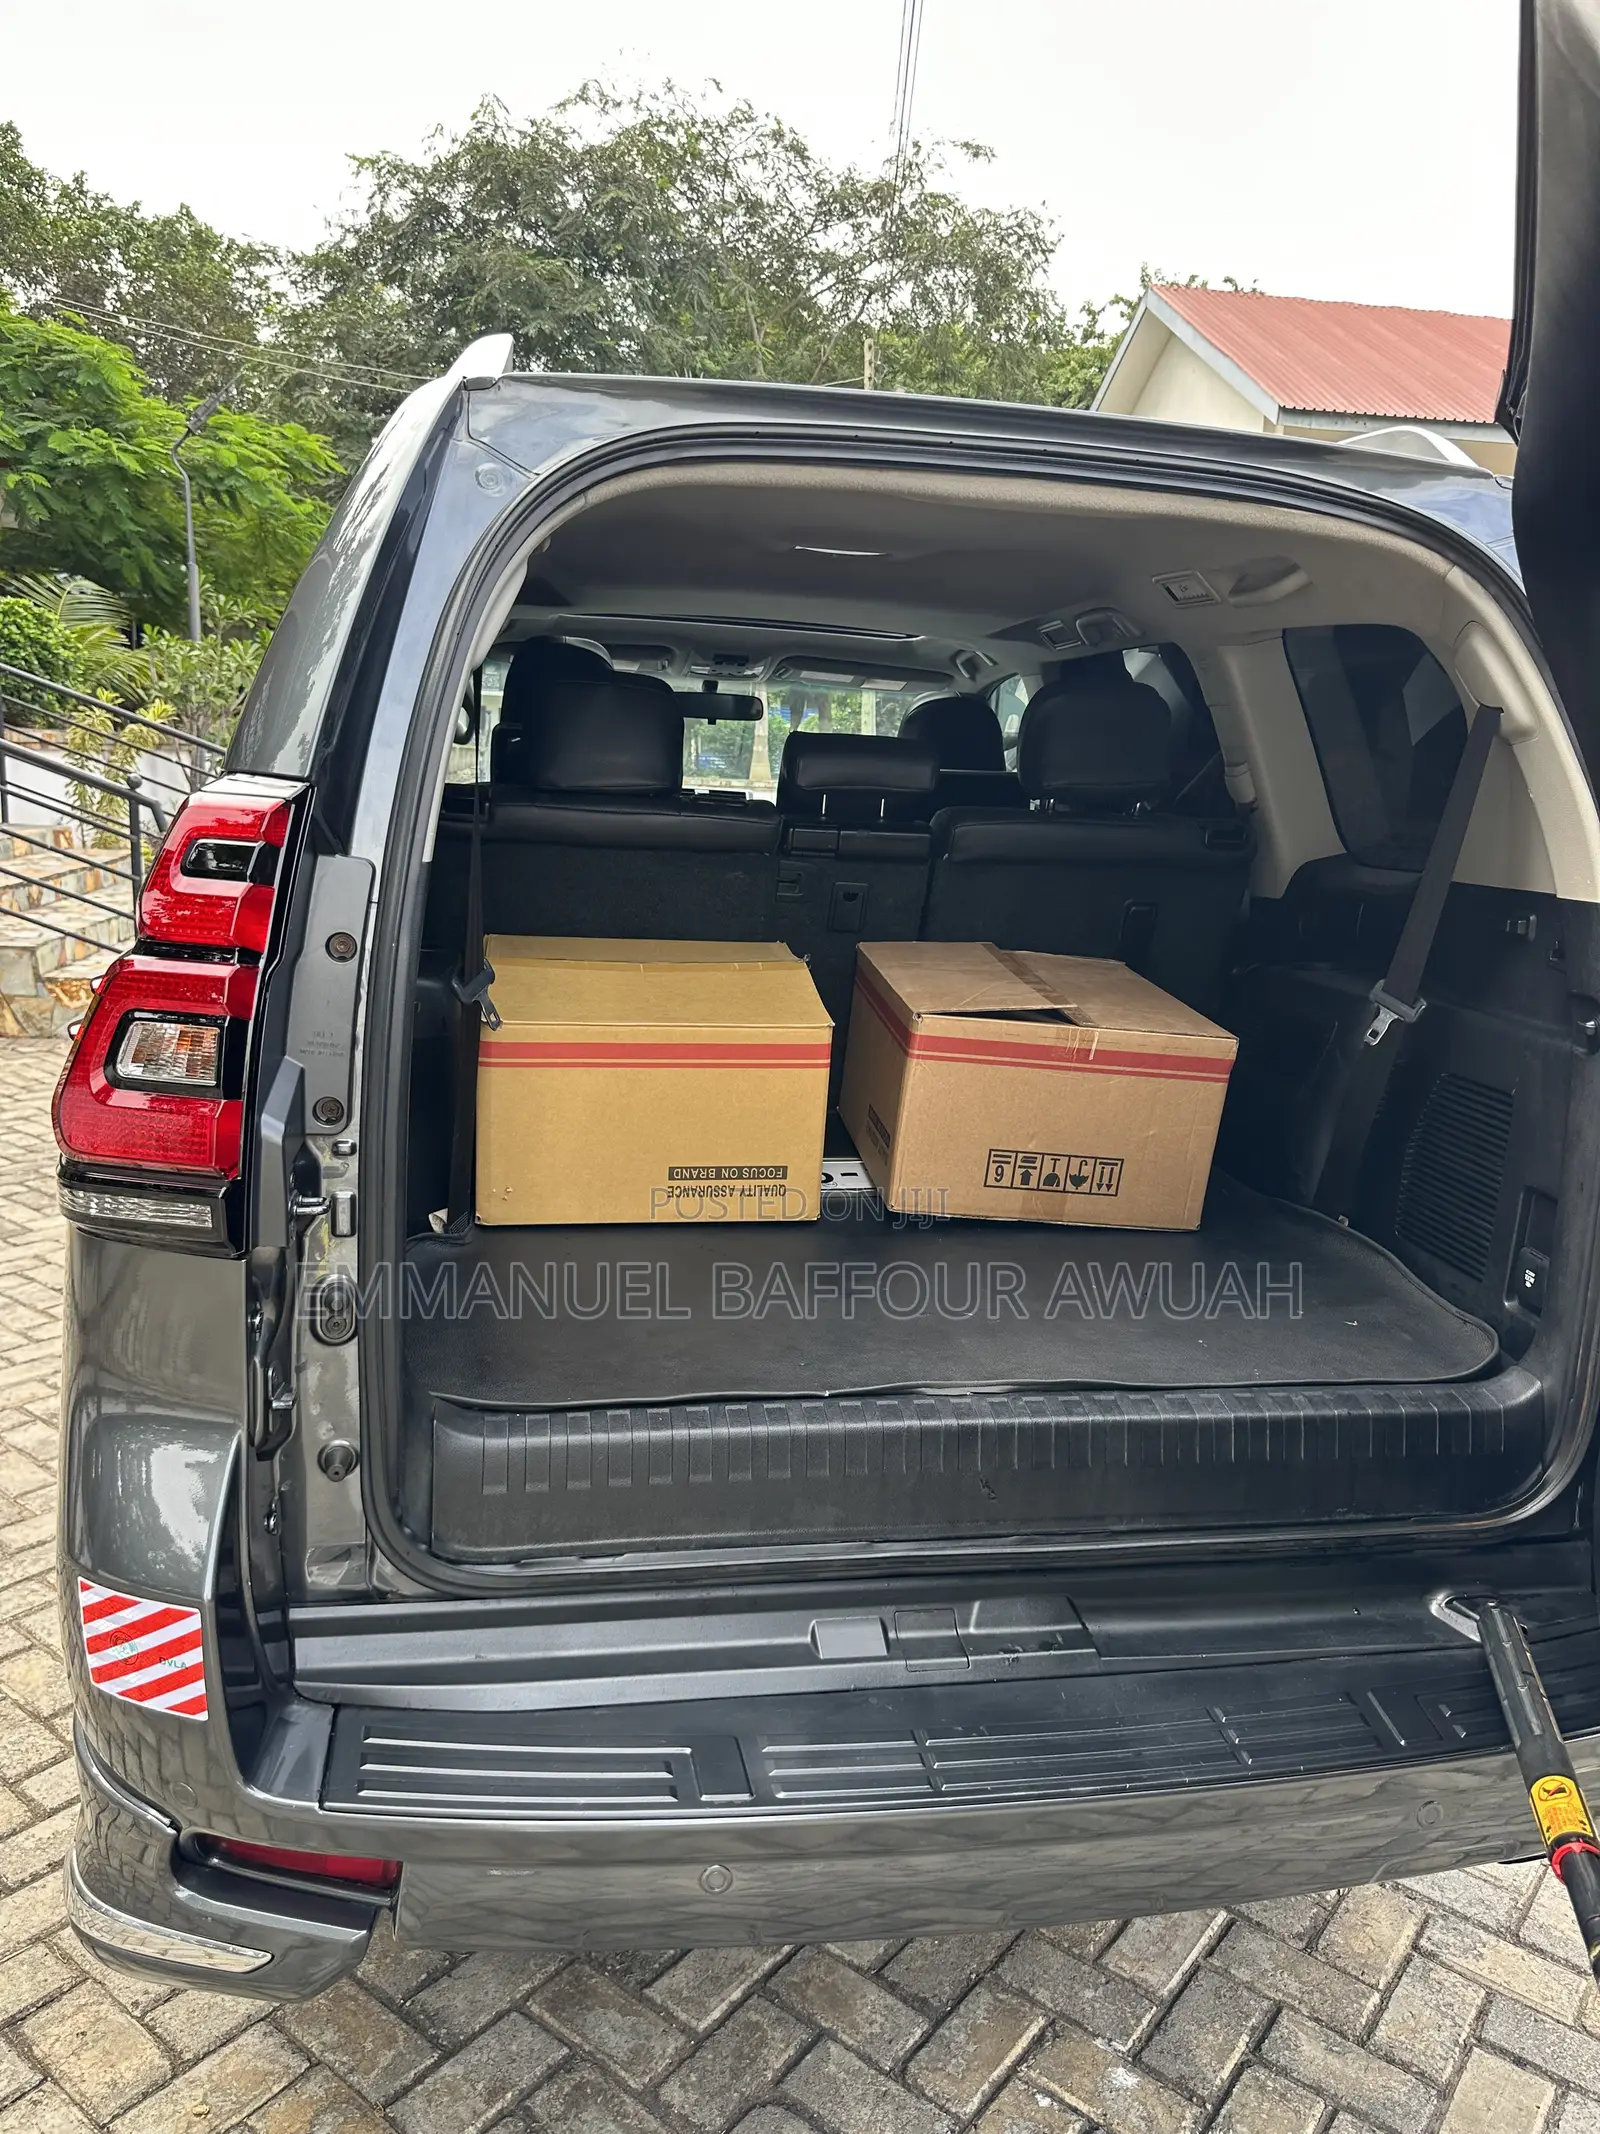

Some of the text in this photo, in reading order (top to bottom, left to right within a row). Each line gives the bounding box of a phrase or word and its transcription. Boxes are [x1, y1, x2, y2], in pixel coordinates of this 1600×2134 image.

[673, 1167, 783, 1179] FOCUS ON BRAND
[667, 1183, 787, 1199] QUALITY ASSURANCE
[158, 1656, 189, 1670] DVLA
